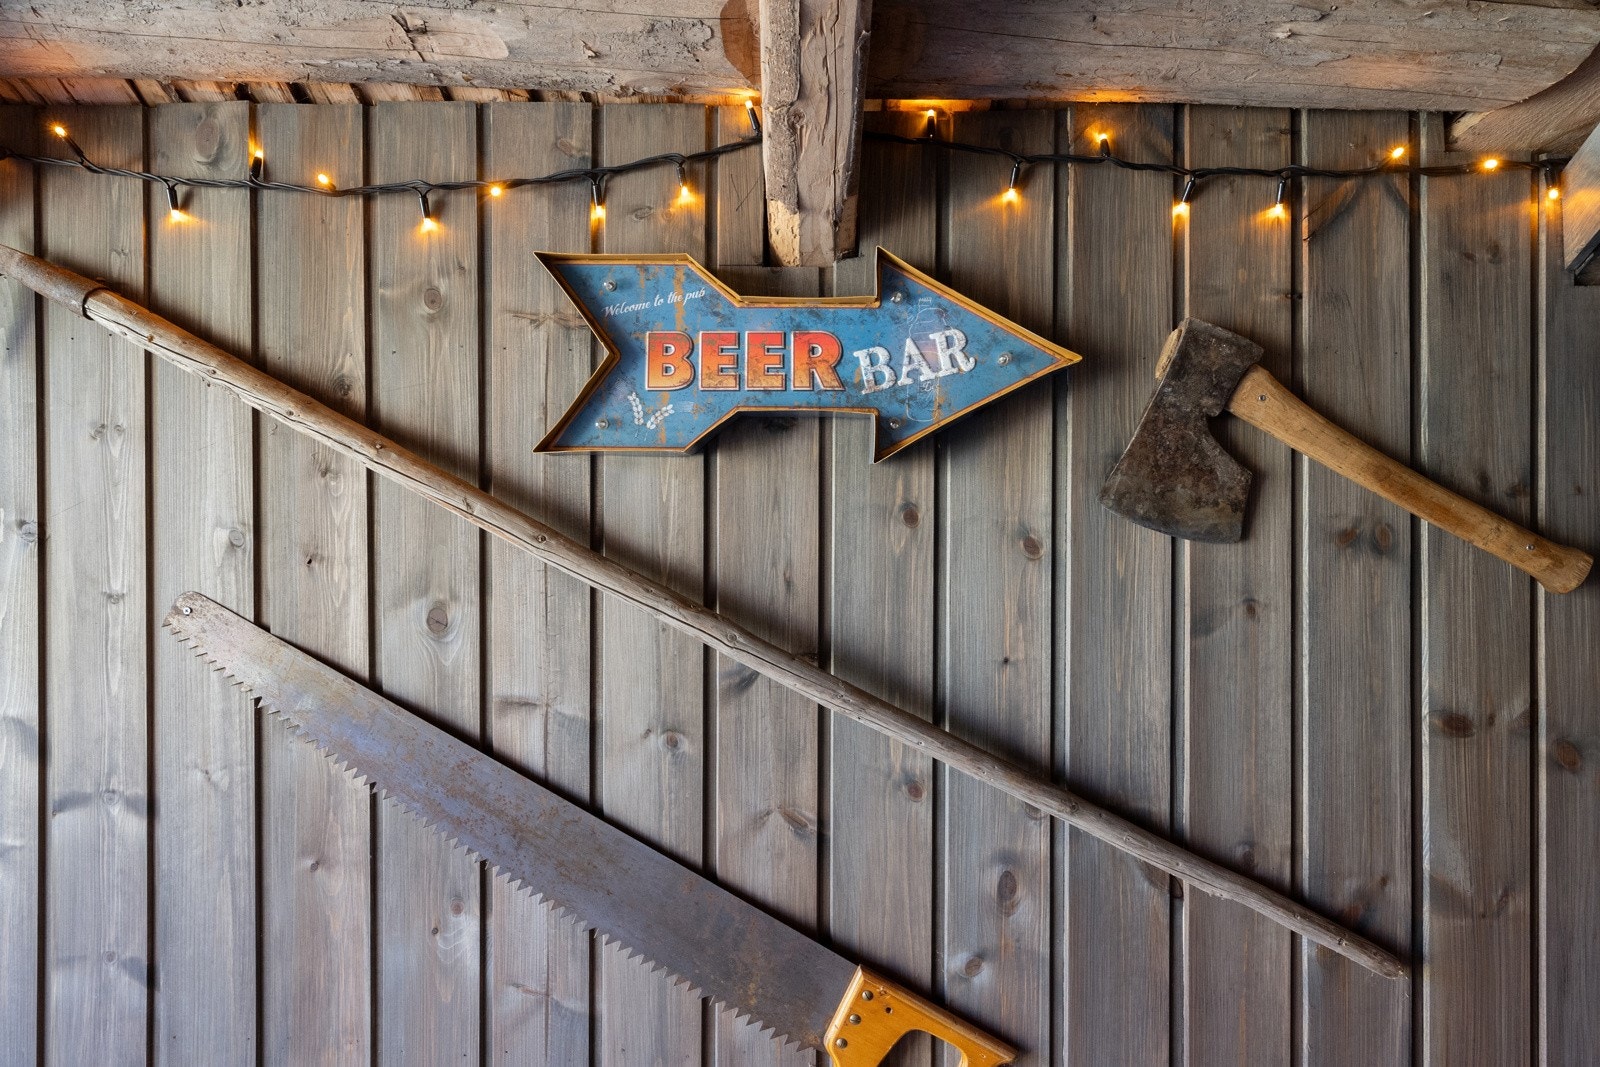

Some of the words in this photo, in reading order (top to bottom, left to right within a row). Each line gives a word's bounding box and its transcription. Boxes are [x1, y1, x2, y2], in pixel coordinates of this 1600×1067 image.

[602, 301, 651, 317] Welcome
[653, 294, 664, 307] to
[667, 291, 683, 304] the
[683, 287, 706, 306] pub
[645, 330, 846, 391] BEER
[853, 328, 976, 395] BAR
